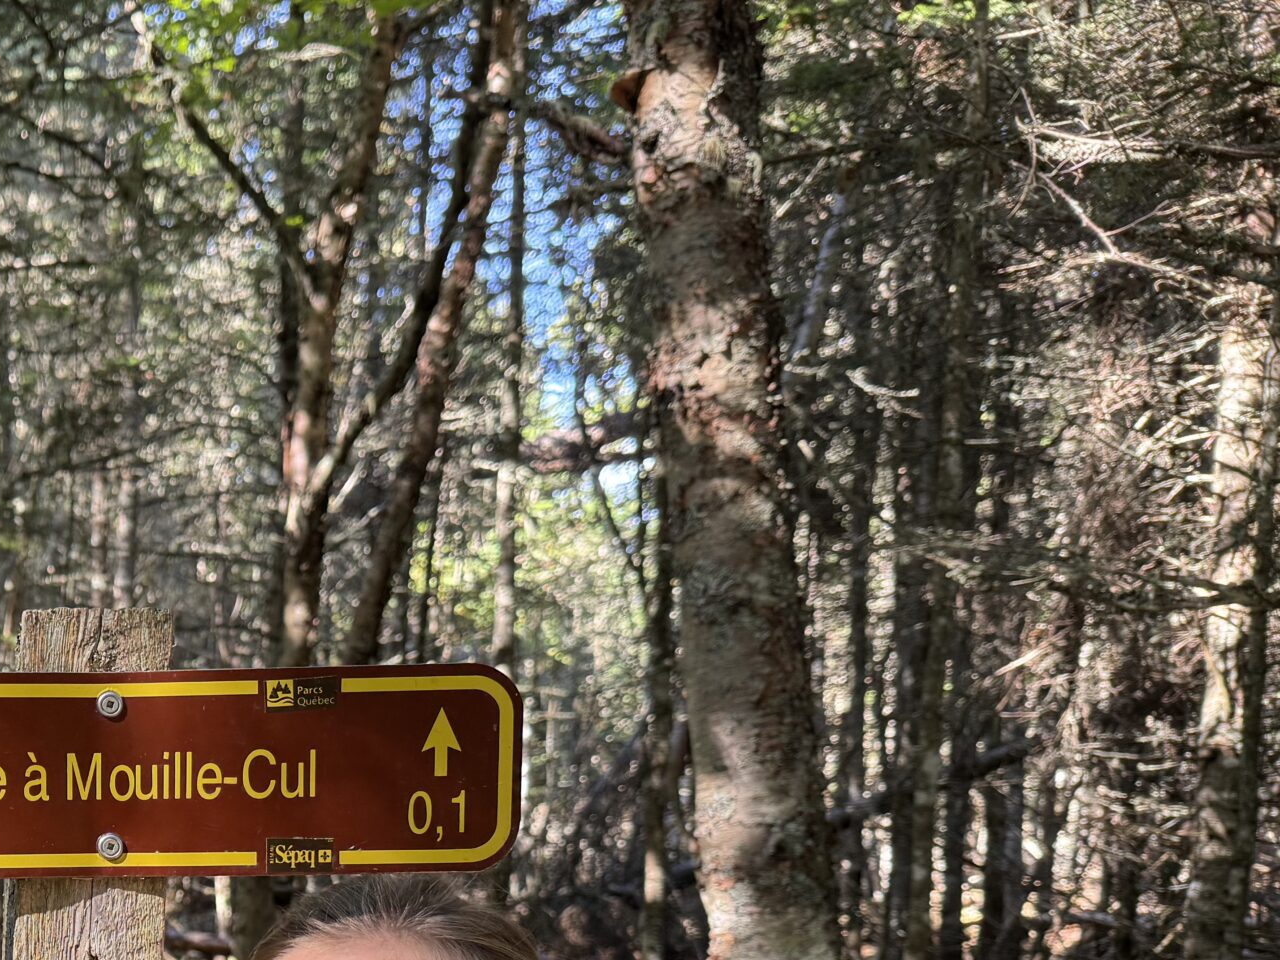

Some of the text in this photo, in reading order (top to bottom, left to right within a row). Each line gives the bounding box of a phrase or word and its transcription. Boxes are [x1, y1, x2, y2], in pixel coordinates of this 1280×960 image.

[296, 685, 324, 696] Parcs
[296, 695, 336, 708] Québec
[23, 751, 51, 803] à
[66, 748, 316, 802] Mouille-Cul
[407, 789, 466, 842] 0,1
[274, 844, 317, 869] Sépaq
